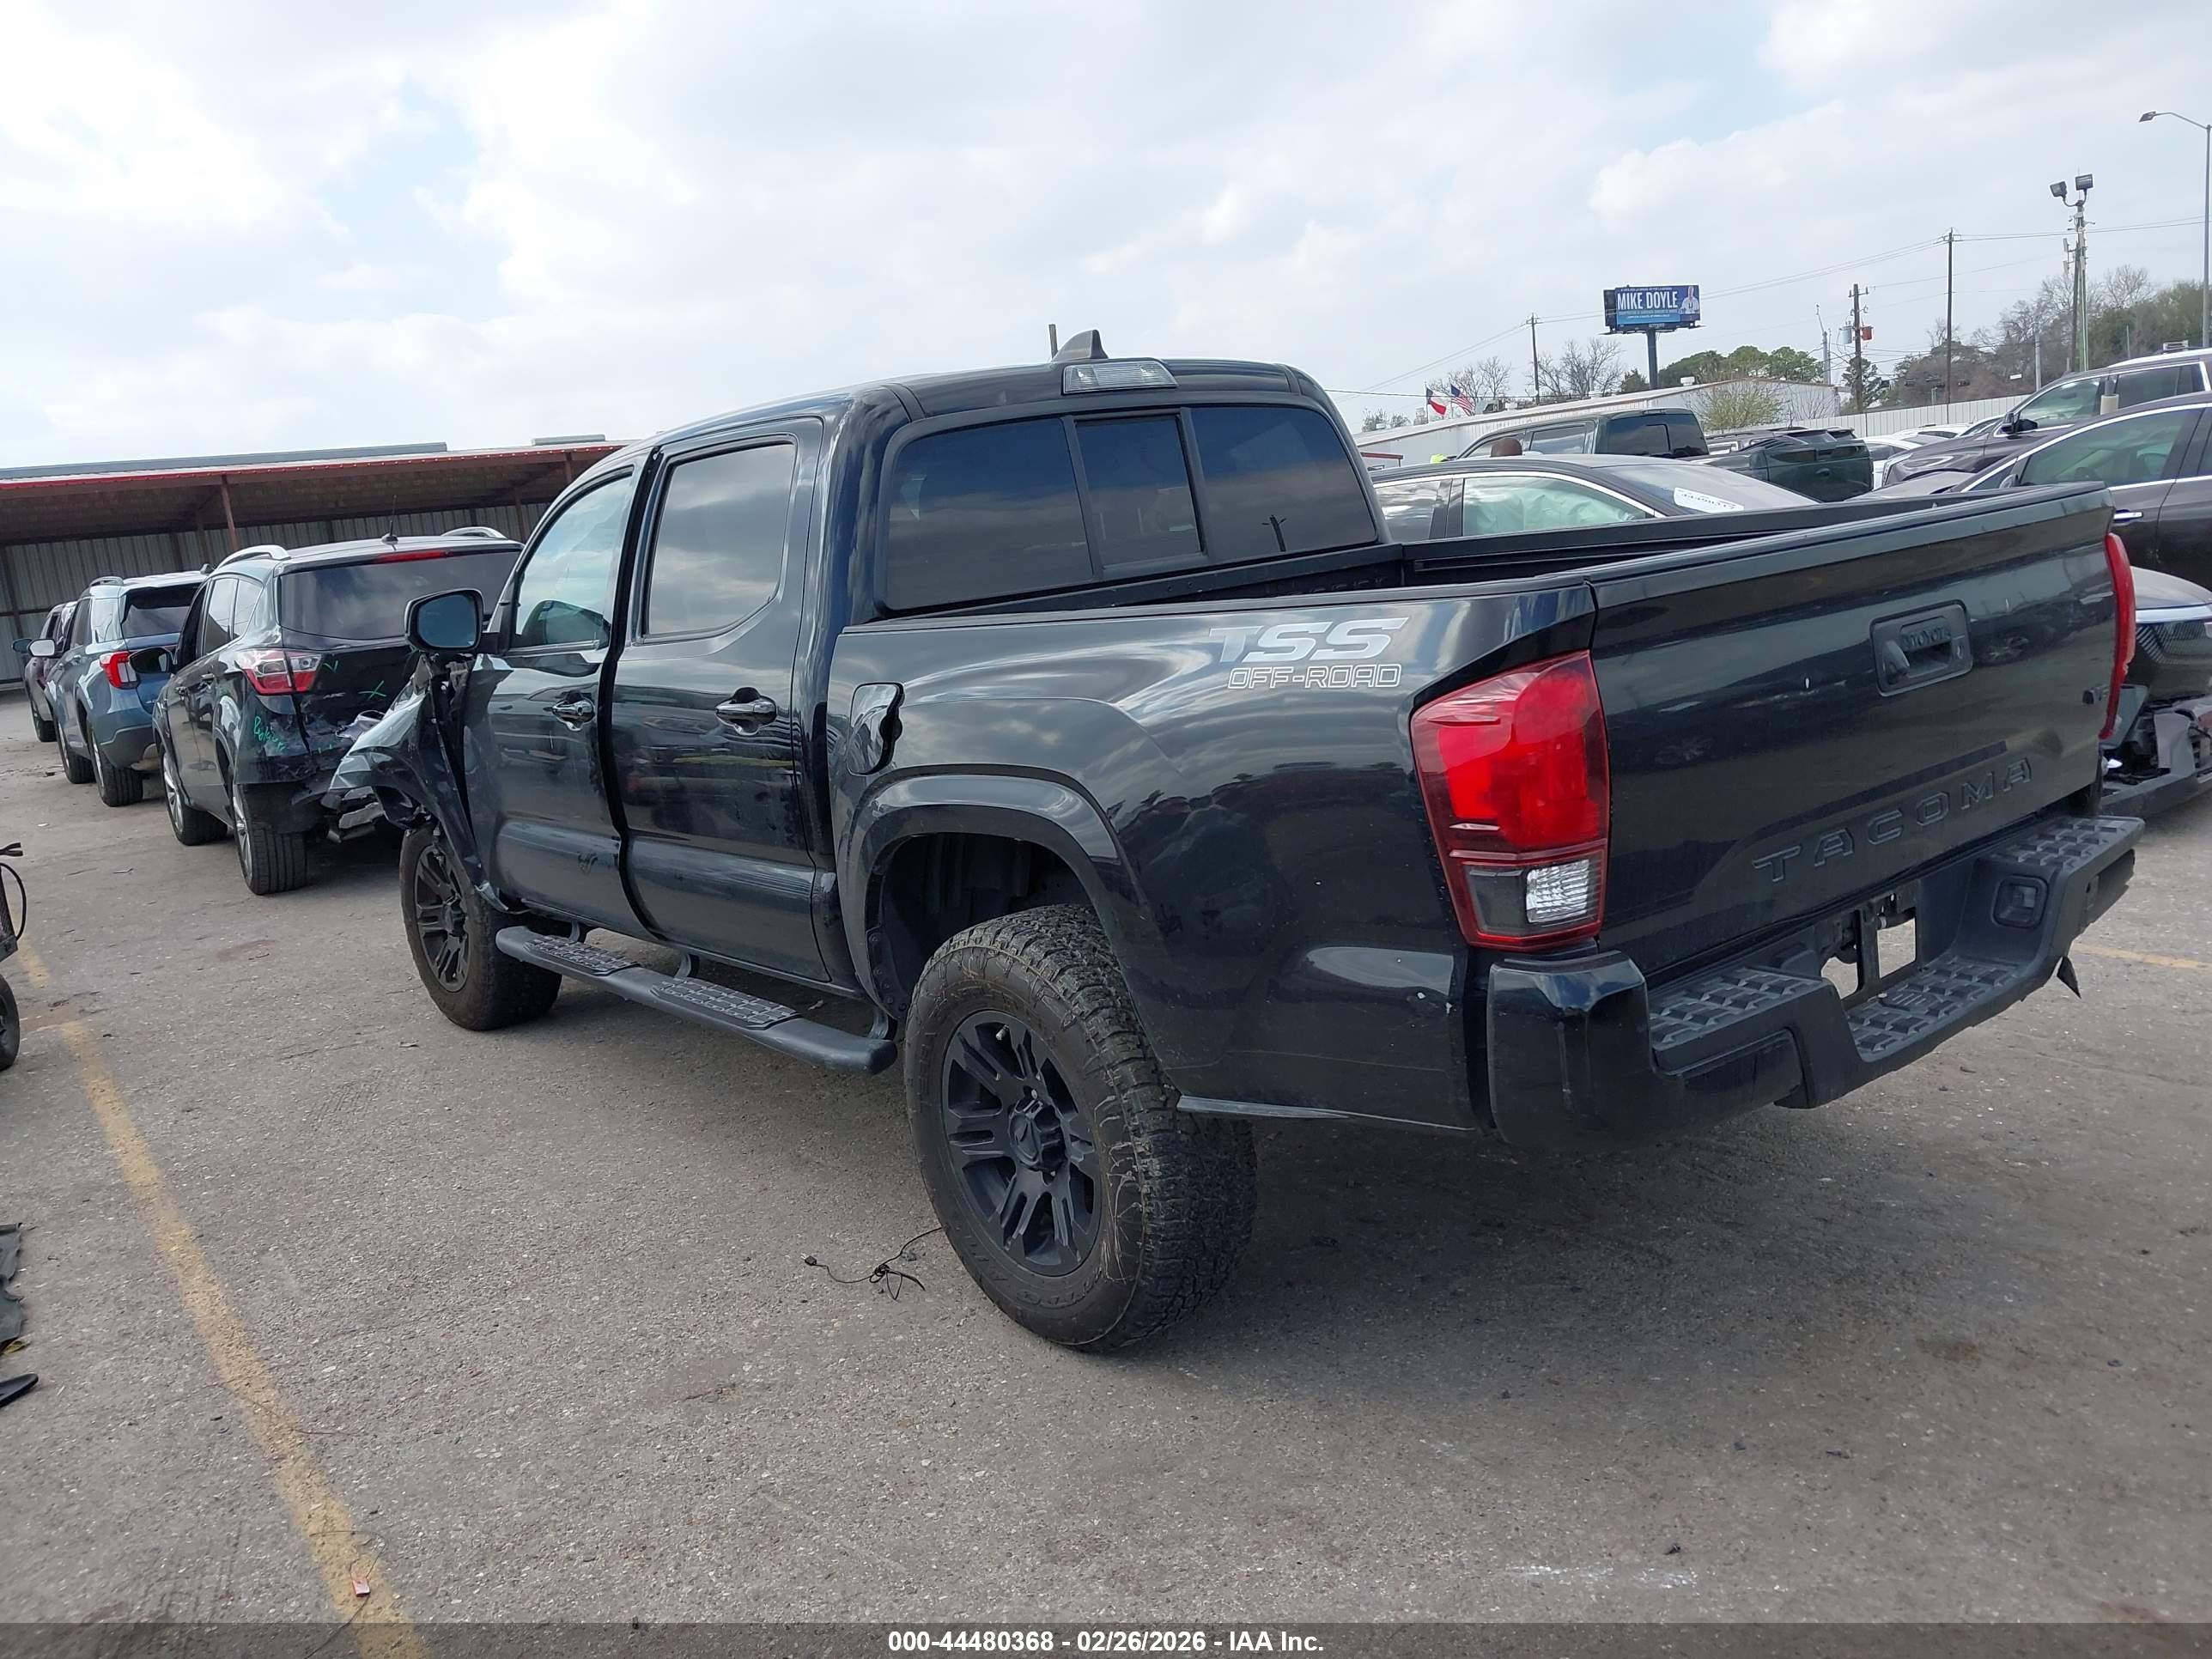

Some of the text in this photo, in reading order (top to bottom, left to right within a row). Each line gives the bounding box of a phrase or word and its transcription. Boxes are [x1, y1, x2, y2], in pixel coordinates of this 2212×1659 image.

[1618, 291, 1678, 310] MIKE DOYLE
[1208, 617, 1409, 664] TSS
[1227, 663, 1402, 690] OFF-ROAD
[1751, 757, 2033, 883] TACOMA
